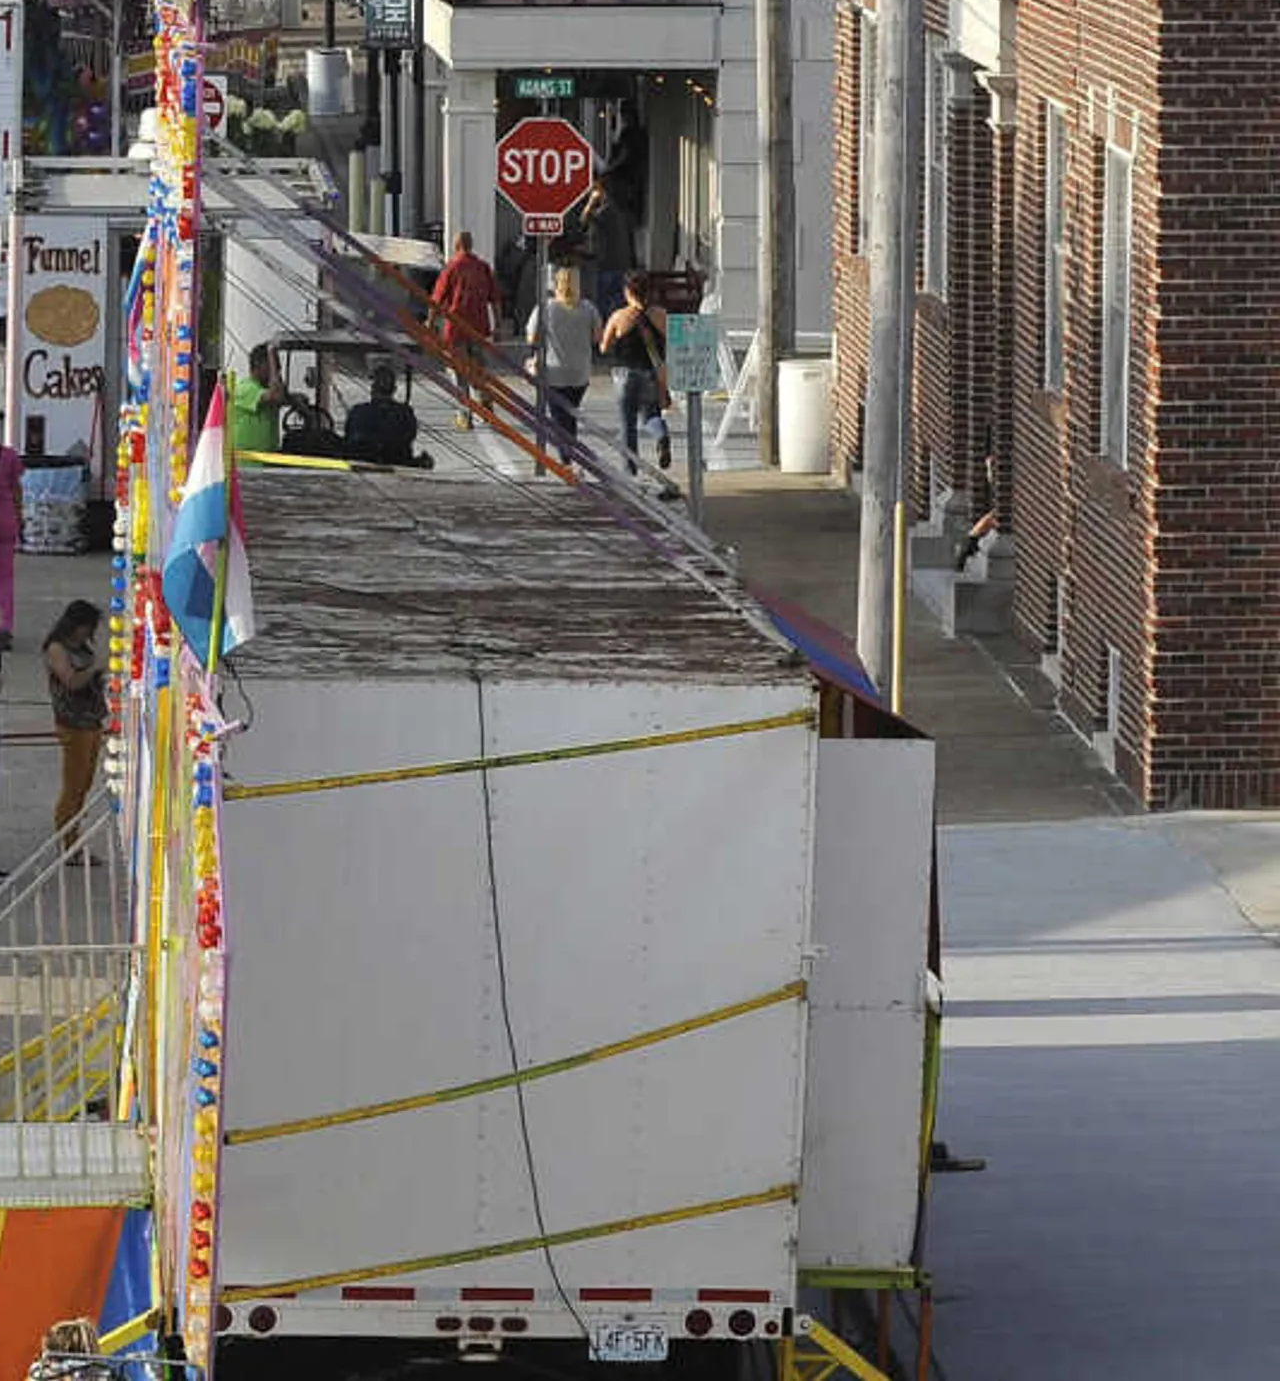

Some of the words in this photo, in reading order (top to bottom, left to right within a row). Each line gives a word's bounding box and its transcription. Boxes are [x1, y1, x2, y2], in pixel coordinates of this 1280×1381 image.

[501, 148, 586, 185] STOP
[23, 236, 101, 275] Funnel
[23, 348, 105, 399] Cakes
